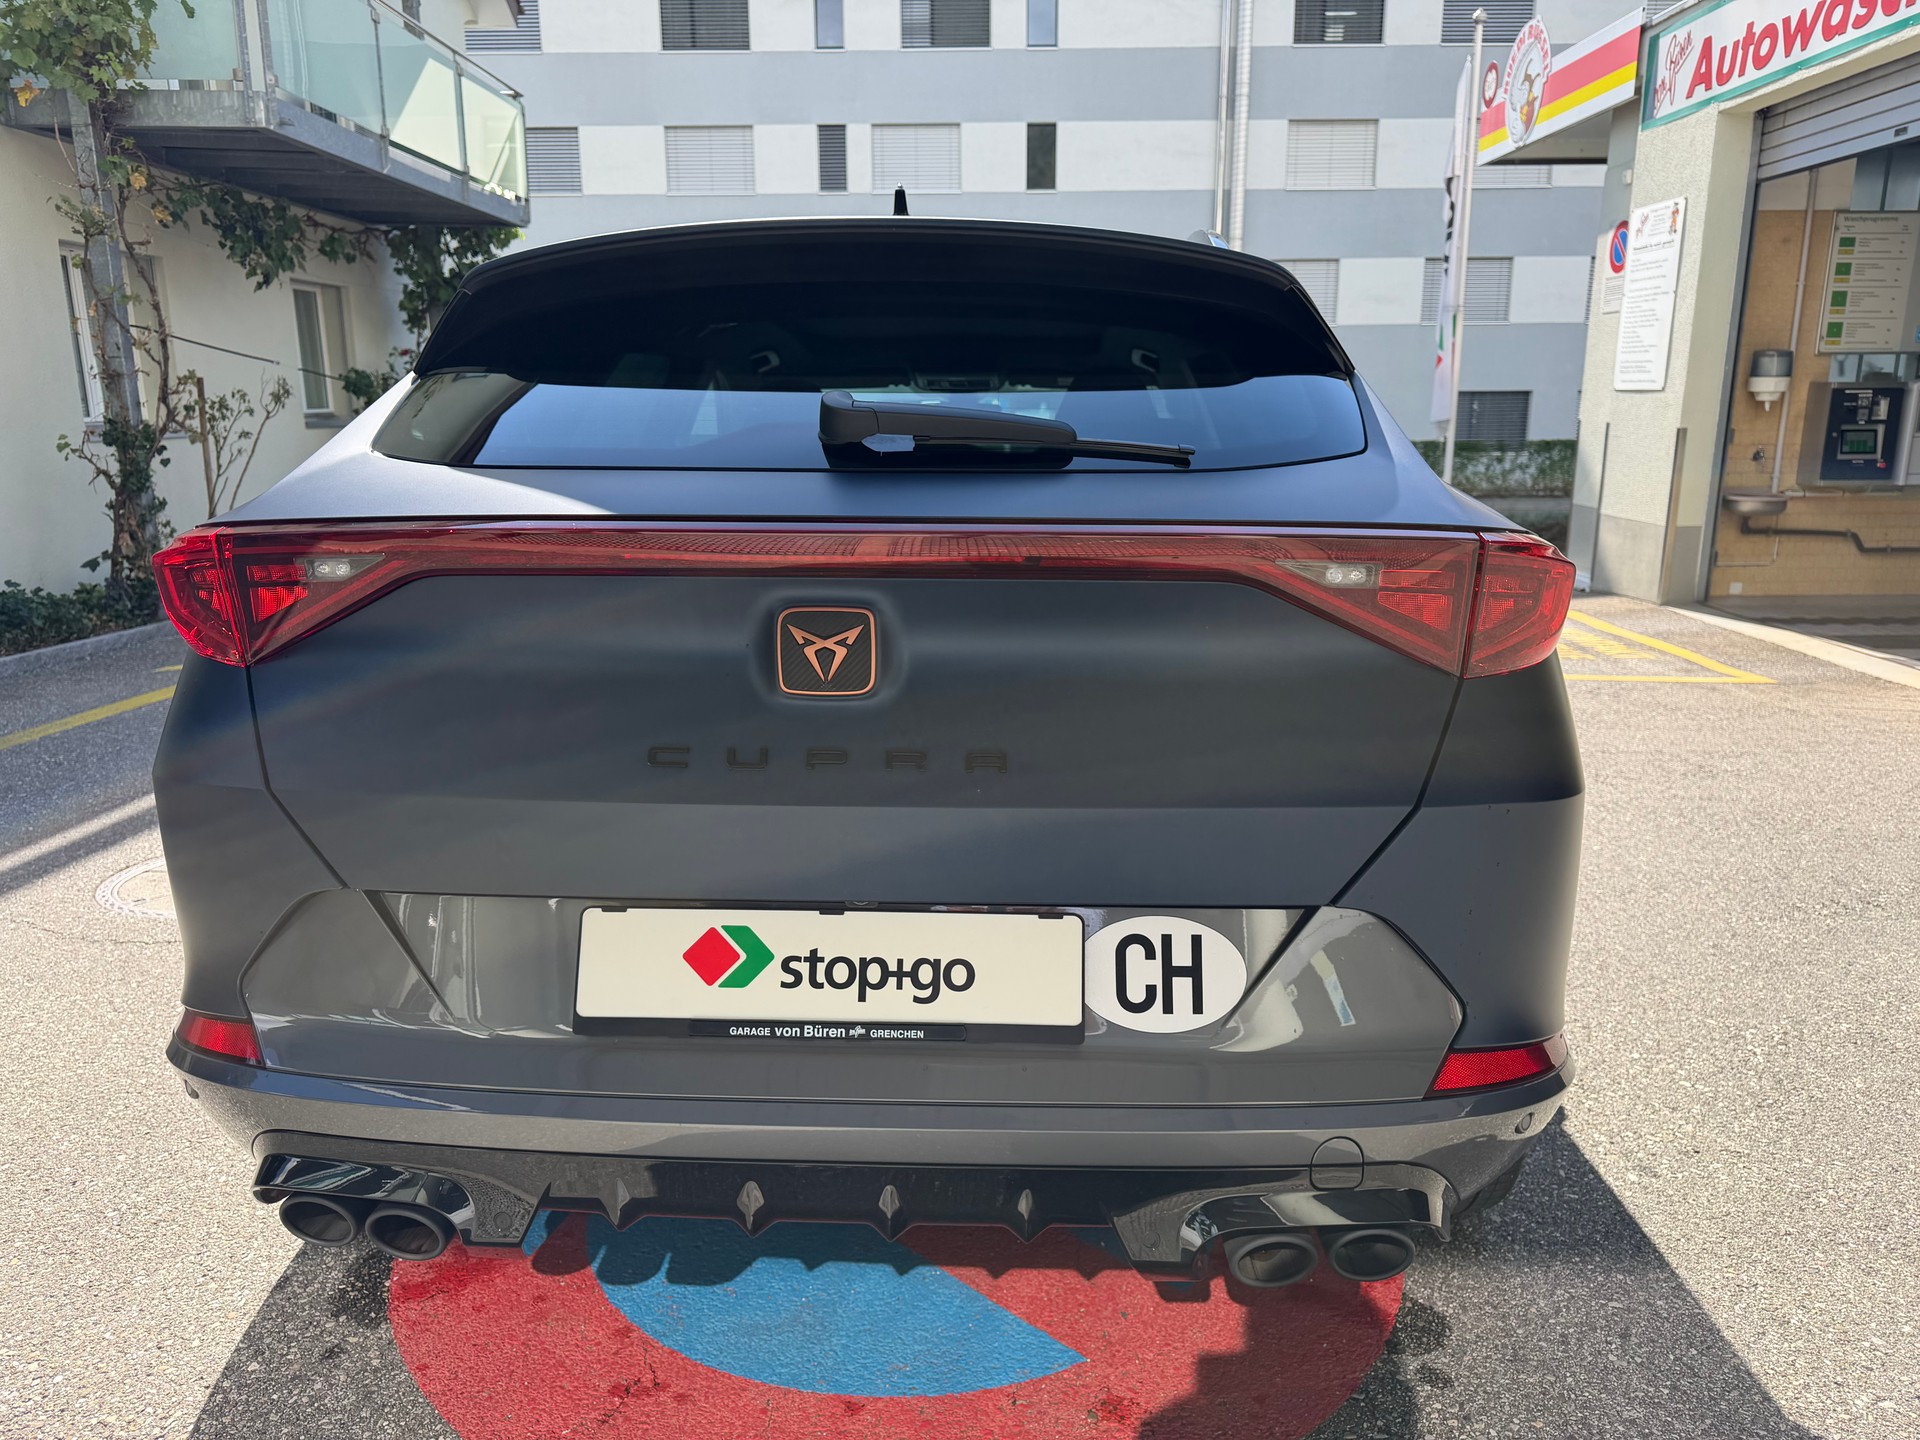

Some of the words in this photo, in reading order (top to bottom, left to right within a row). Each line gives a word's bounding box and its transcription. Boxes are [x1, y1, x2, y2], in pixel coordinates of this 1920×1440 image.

[647, 746, 1008, 773] CUPRA
[779, 947, 976, 1005] stop+go
[1114, 933, 1203, 1016] CH
[729, 1026, 771, 1036] GARAGE
[775, 1027, 800, 1037] von
[804, 1025, 846, 1038] Büren
[870, 1029, 925, 1039] GRENCHEN
